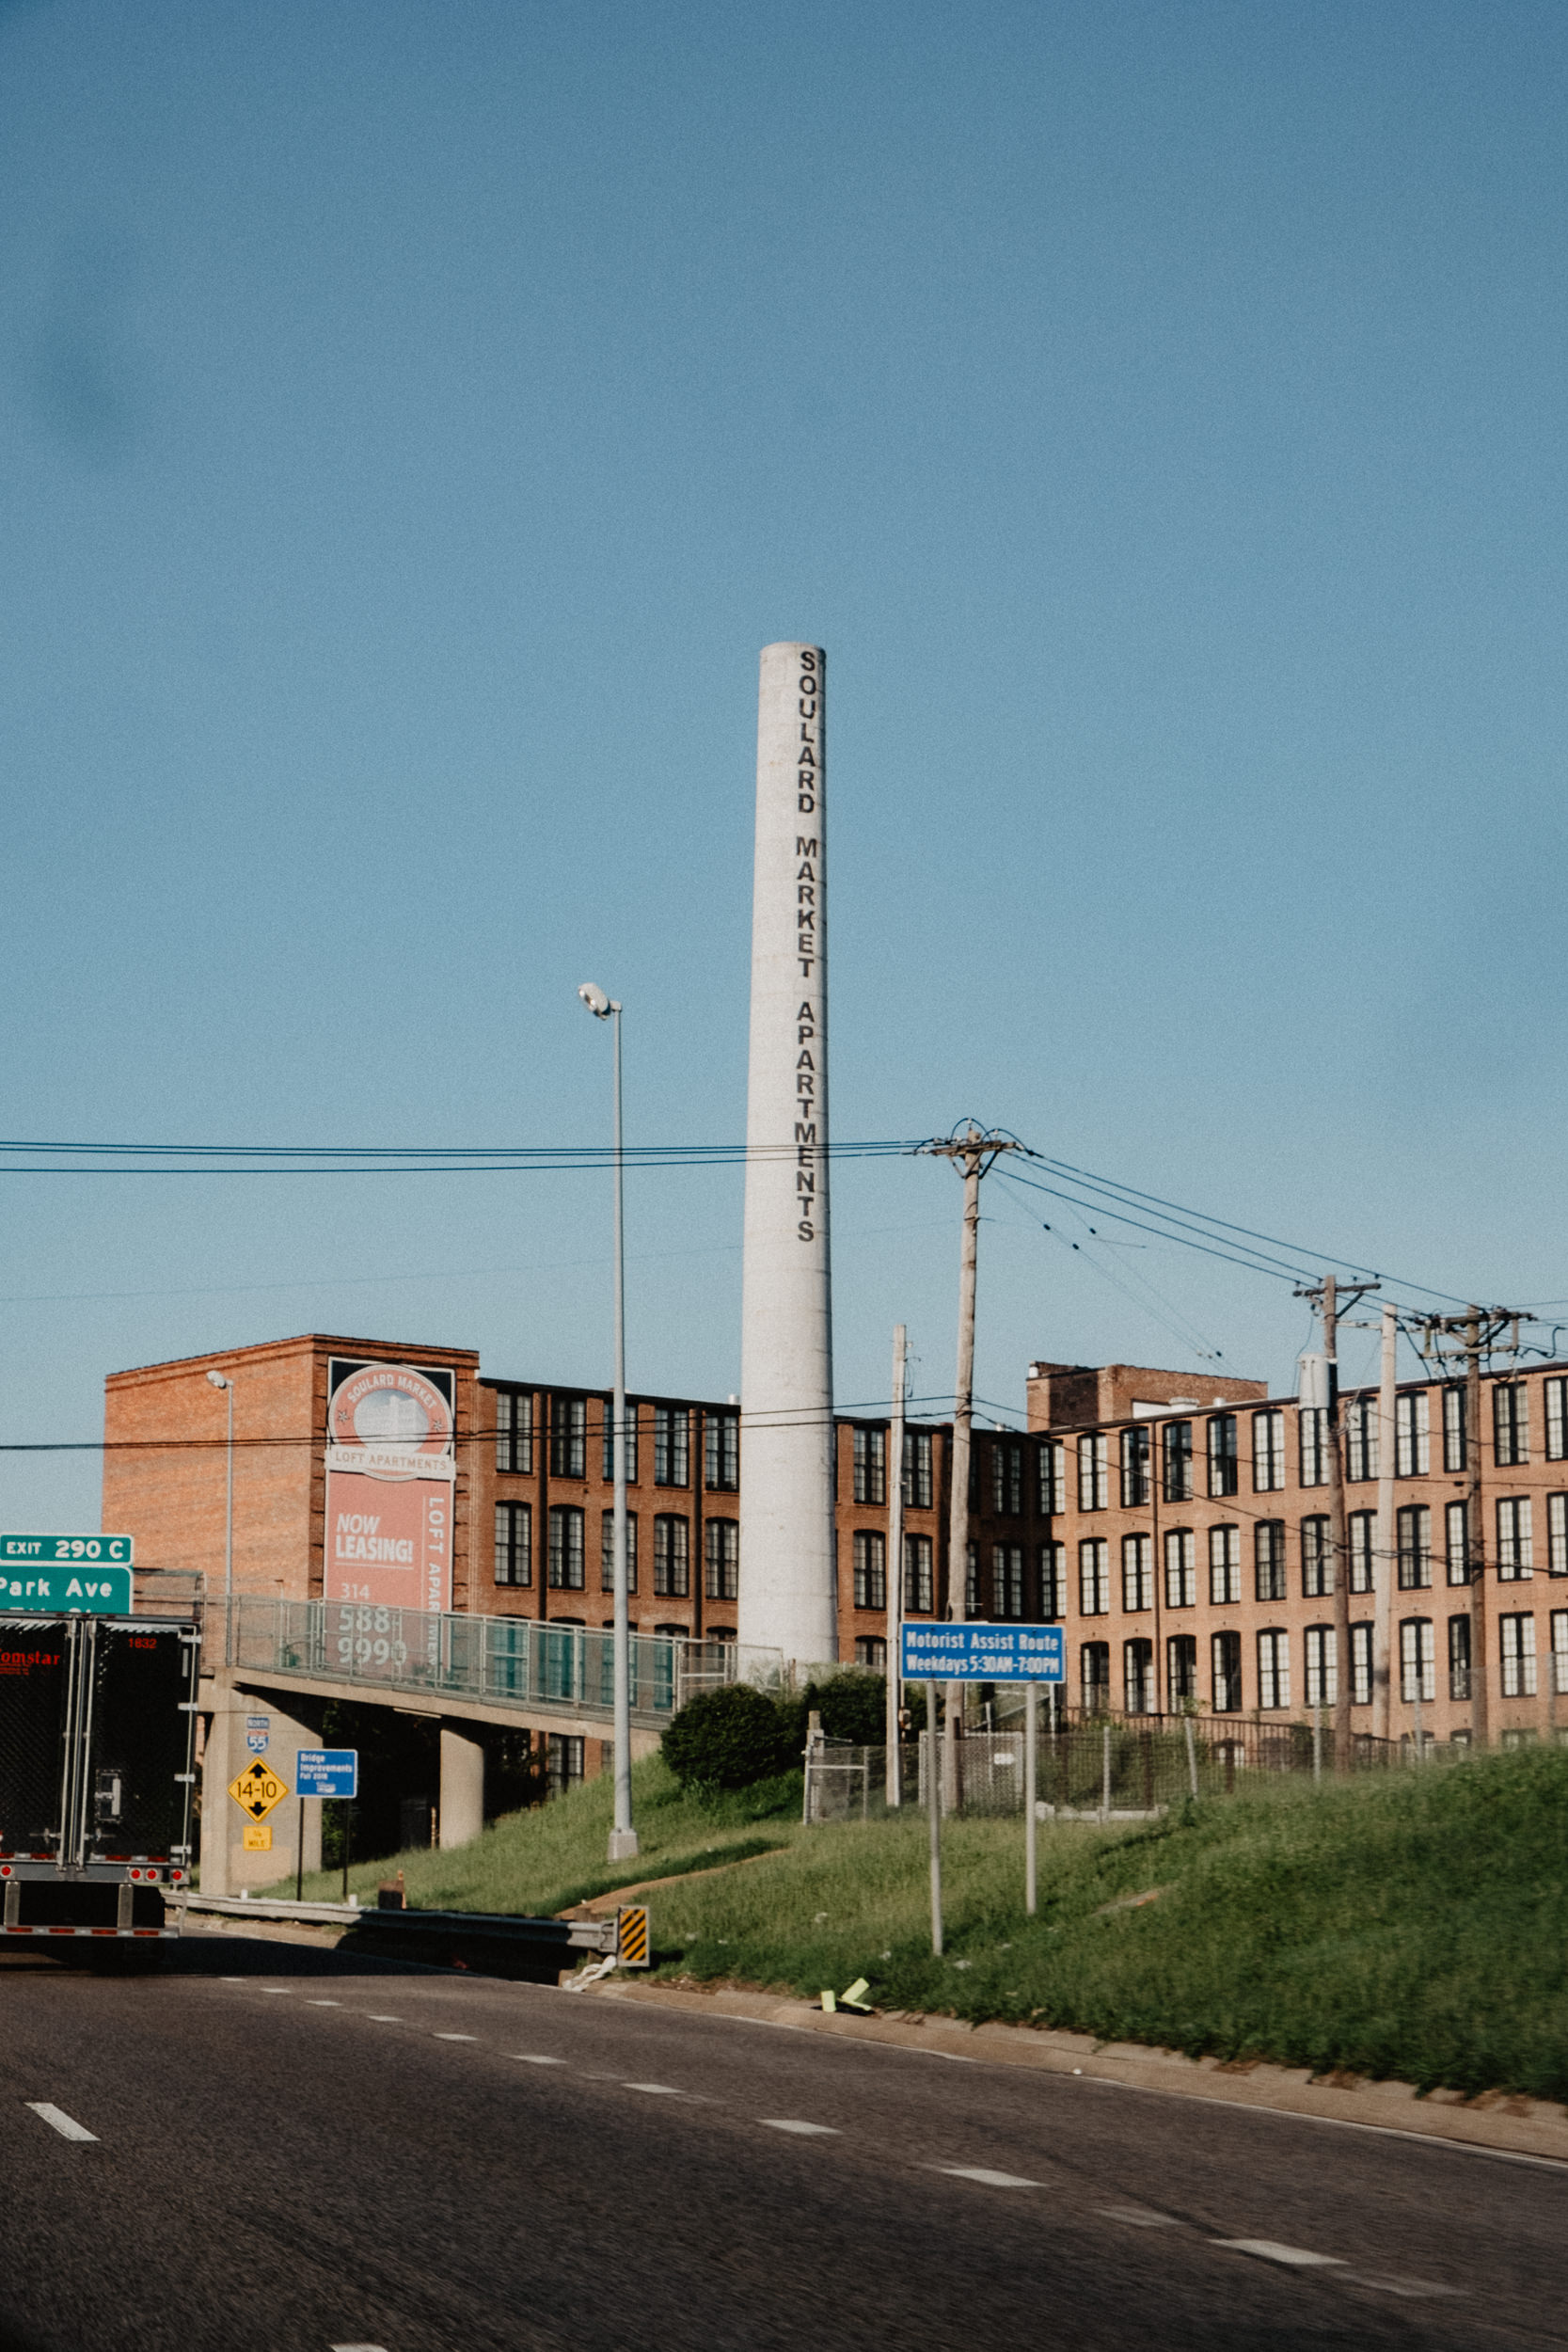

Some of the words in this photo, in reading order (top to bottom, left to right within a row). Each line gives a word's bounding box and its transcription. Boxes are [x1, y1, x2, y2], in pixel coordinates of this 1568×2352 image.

[798, 651, 816, 814] SOULARD
[796, 836, 817, 978] MARKET
[795, 1001, 816, 1242] APARTMENTS
[347, 1375, 394, 1403] SOULARD
[398, 1375, 436, 1409] MARKET
[335, 1452, 365, 1463] LOFT
[369, 1455, 447, 1471] APARTMENTS
[337, 1513, 380, 1535] NOW
[428, 1497, 445, 1554] LOFT
[7, 1541, 42, 1555] EXIT
[55, 1539, 102, 1559] 290
[109, 1540, 123, 1559] C
[336, 1535, 414, 1564] LEASING!
[65, 1578, 113, 1597] Ave
[341, 1582, 371, 1599] 314
[128, 1638, 157, 1649] 1832
[906, 1631, 965, 1649] Motorist
[970, 1632, 1015, 1650] Assist
[1019, 1634, 1059, 1651] Route
[0, 1648, 61, 1665] omstar
[338, 1637, 407, 1666] 9990
[906, 1654, 968, 1676] Weekdays
[248, 1736, 267, 1751] 55
[301, 1754, 325, 1763] Bridge
[237, 1781, 277, 1799] 14-10
